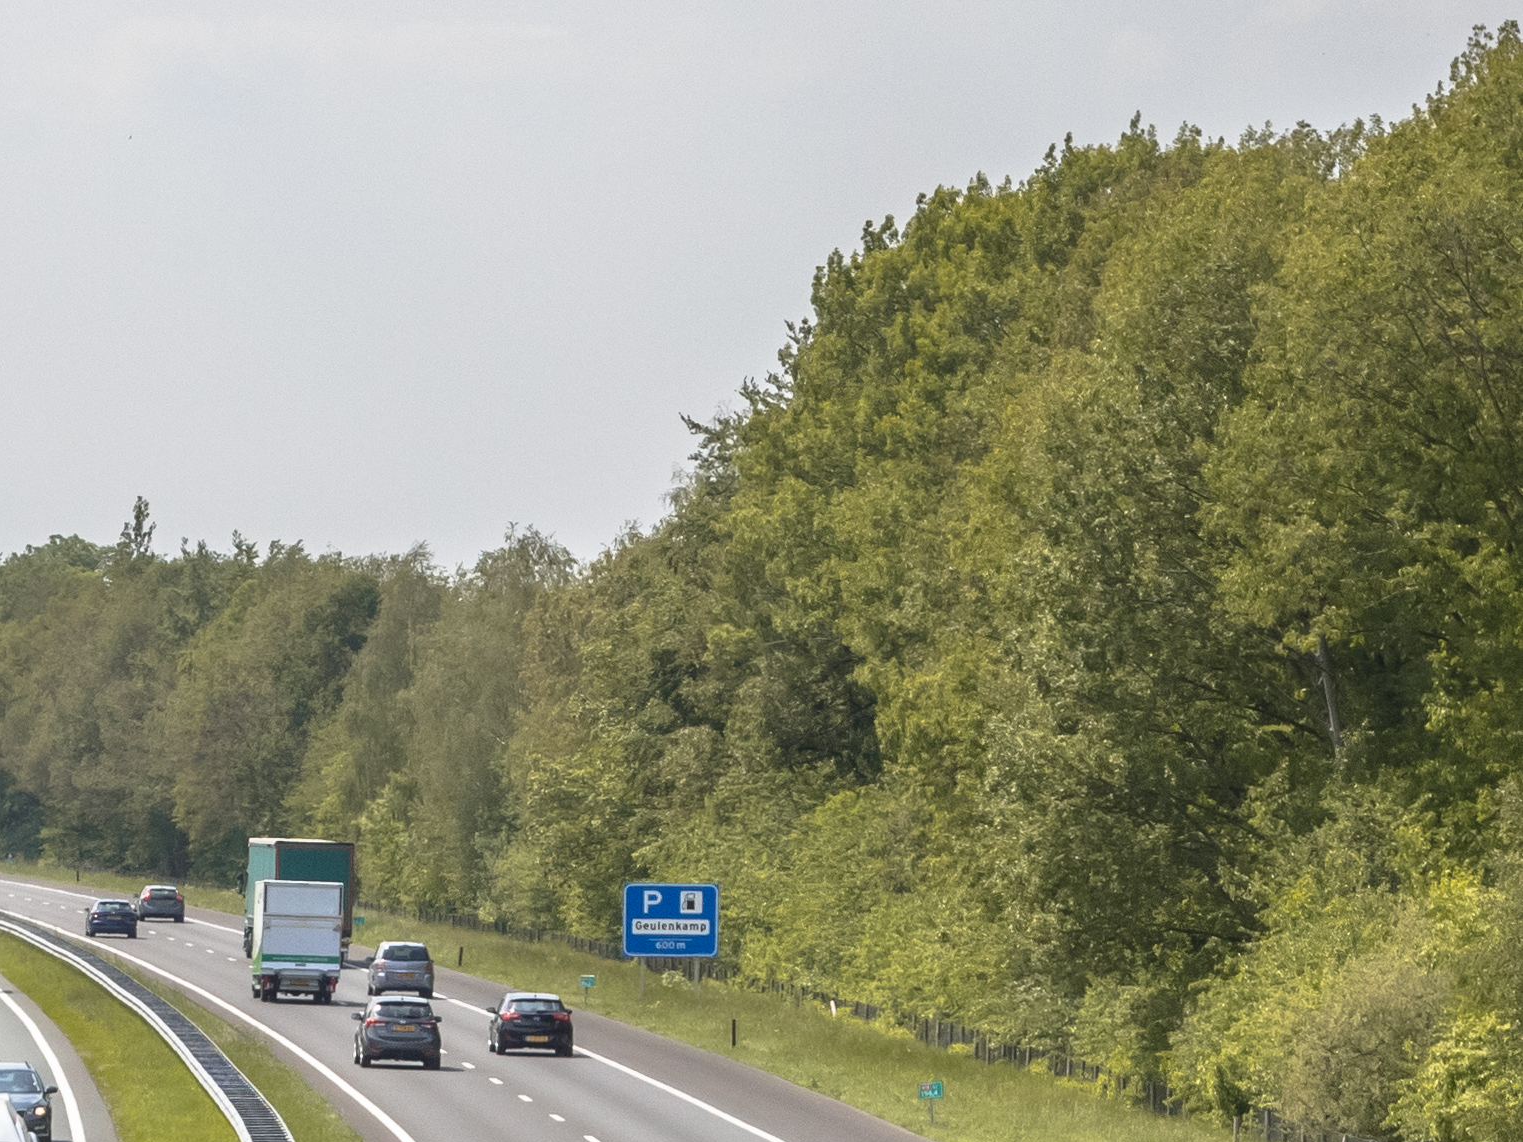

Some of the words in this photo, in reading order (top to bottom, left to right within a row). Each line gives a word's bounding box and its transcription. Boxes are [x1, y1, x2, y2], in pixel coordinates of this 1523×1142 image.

[643, 890, 663, 914] P
[635, 920, 707, 932] Geulenkamp
[655, 941, 675, 949] 600
[676, 941, 686, 949] m
